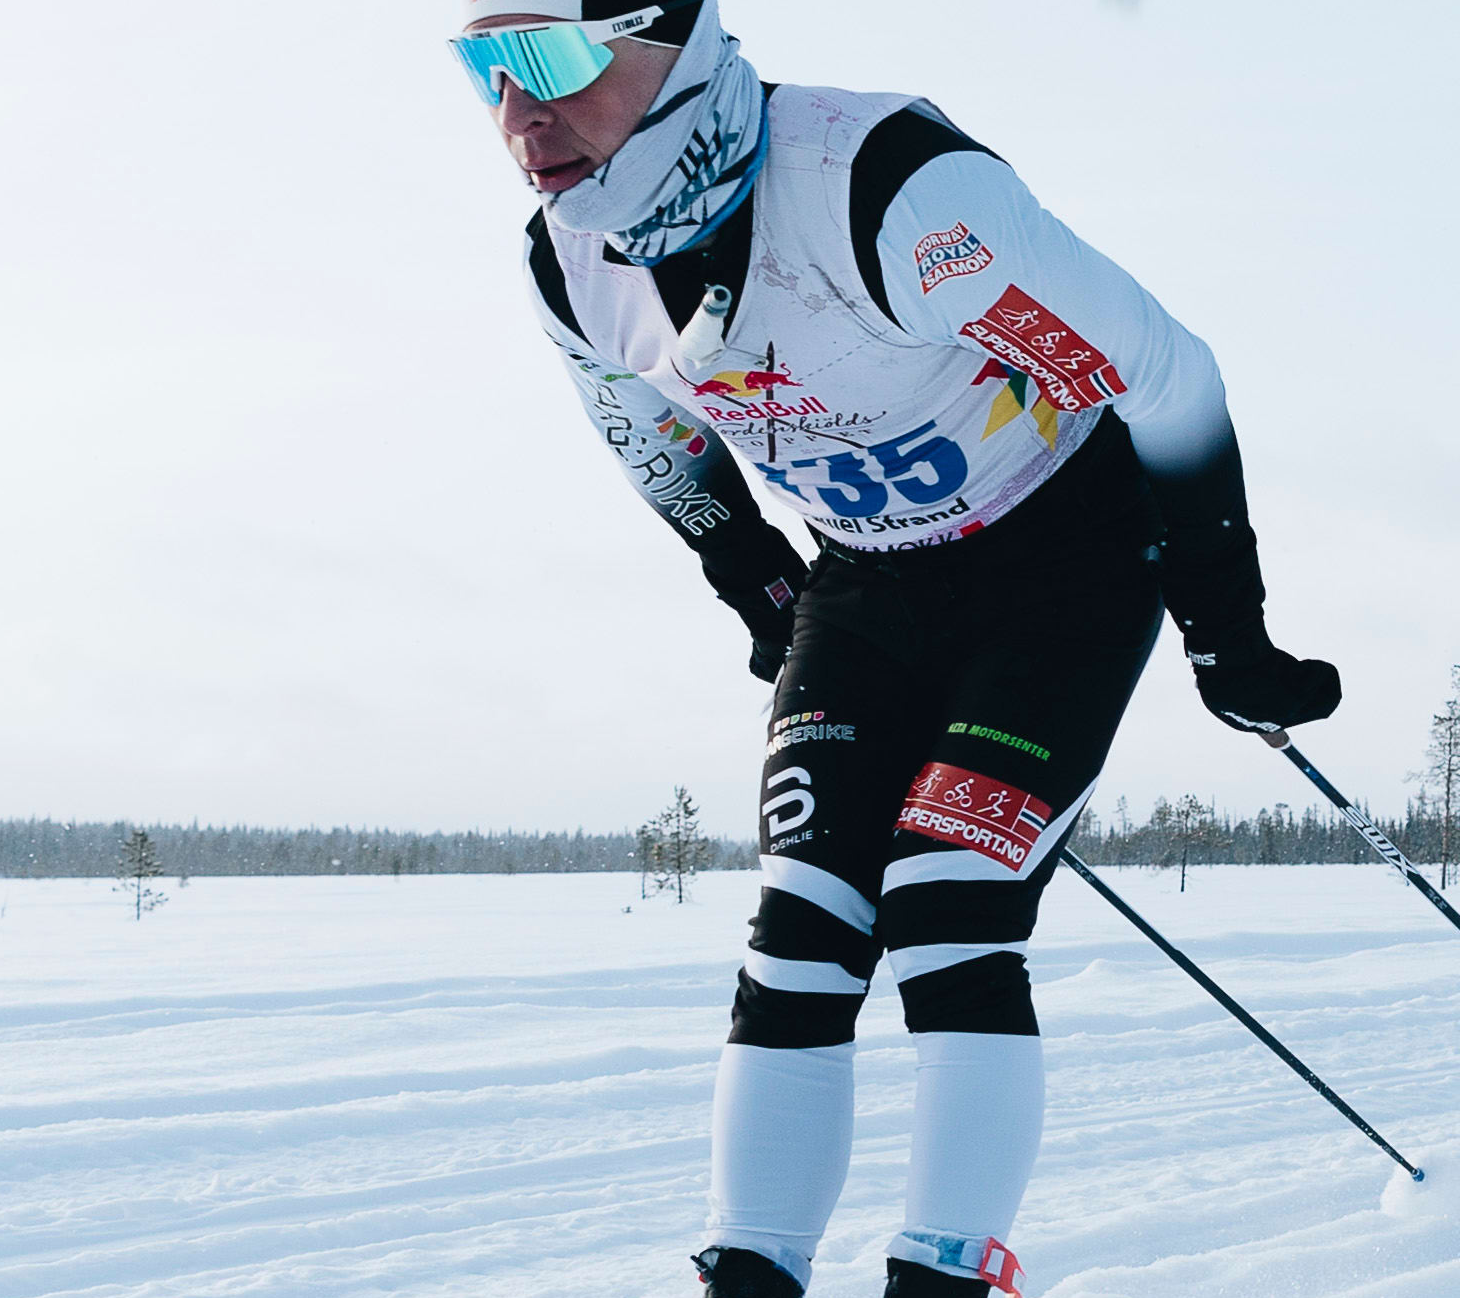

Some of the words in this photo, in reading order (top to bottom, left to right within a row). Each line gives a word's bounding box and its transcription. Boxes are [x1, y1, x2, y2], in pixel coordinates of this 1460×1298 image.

[916, 224, 966, 258] NORWAY
[921, 239, 978, 274] ROYAL
[924, 249, 991, 288] SALMON
[702, 405, 764, 422] Red
[767, 396, 829, 418] Bull
[866, 496, 972, 534] Strand
[765, 723, 856, 760] ARGERIKE
[968, 724, 1051, 762] MOTORSENTER
